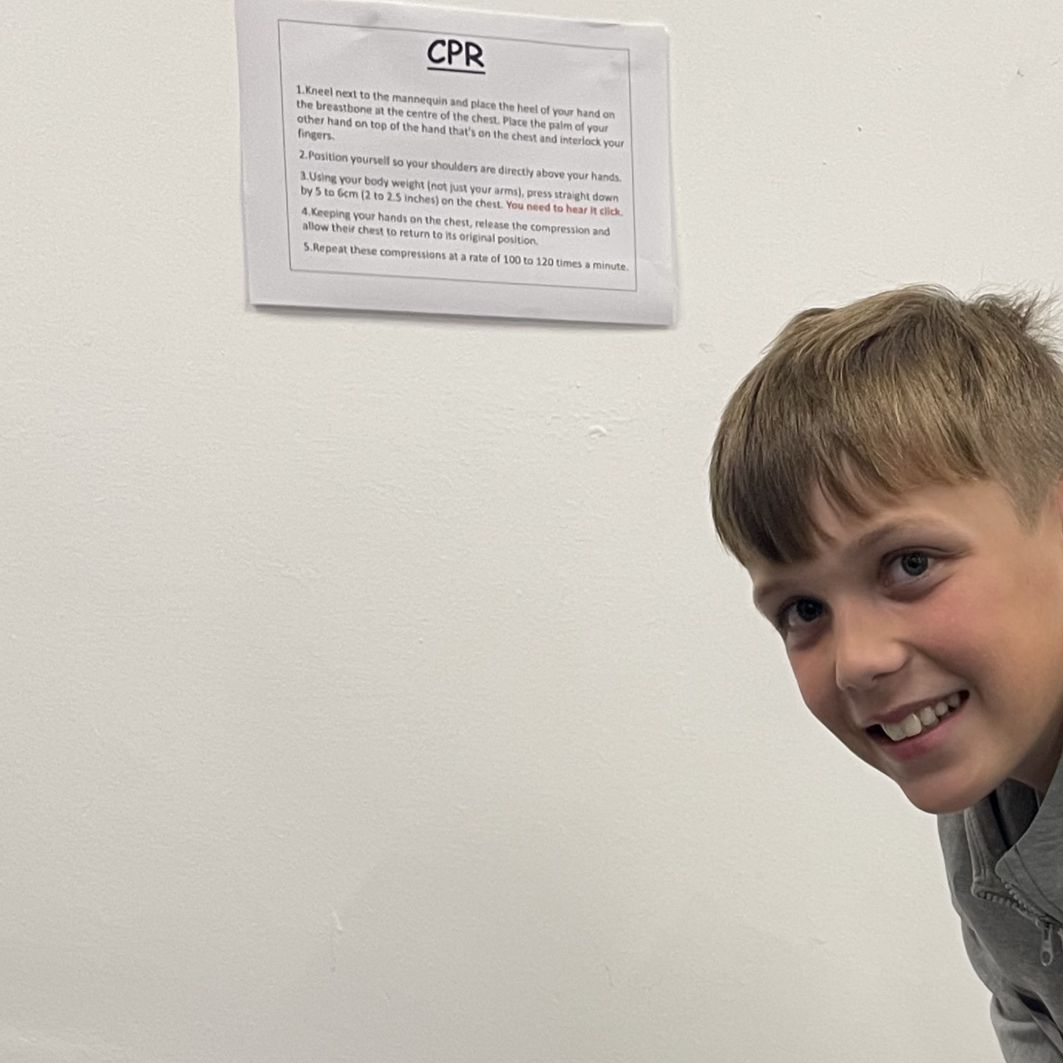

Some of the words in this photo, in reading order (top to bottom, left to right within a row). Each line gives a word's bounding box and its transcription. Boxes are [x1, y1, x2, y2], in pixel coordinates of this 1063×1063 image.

[426, 39, 485, 68] CPR
[296, 100, 314, 109] the
[315, 101, 373, 114] breastbone
[374, 107, 385, 115] at
[387, 107, 404, 116] the
[406, 111, 438, 119] centre
[439, 111, 451, 120] of
[452, 112, 469, 121] the
[471, 114, 500, 124] chest.
[502, 116, 528, 127] Place
[529, 119, 547, 128] the
[548, 121, 573, 130] palm
[574, 122, 585, 130] of
[335, 90, 358, 98] next
[359, 91, 371, 99] to
[372, 92, 390, 101] the
[391, 95, 448, 106] mannequin
[449, 99, 469, 107] and
[470, 100, 497, 109] place
[498, 102, 515, 111] the
[516, 104, 539, 113] heel
[540, 106, 551, 114] of
[576, 109, 601, 118] hand
[296, 115, 324, 125] other
[327, 117, 352, 127] hand
[370, 121, 387, 131] top
[390, 122, 400, 130] of
[402, 123, 419, 132] the
[421, 124, 446, 134] hand
[448, 127, 476, 136] that's
[493, 130, 509, 139] the
[511, 132, 537, 142] chest
[540, 135, 558, 143] and
[560, 136, 601, 146] interlock
[297, 128, 338, 140] fingers.
[350, 156, 391, 165] yourself
[405, 161, 429, 169] your
[430, 160, 479, 172] shoulders
[497, 166, 534, 178] directly
[535, 169, 566, 178] above
[566, 173, 589, 181] your
[590, 172, 623, 182] hands.
[300, 186, 313, 197] by
[315, 187, 322, 196] 5
[324, 188, 335, 196] to
[336, 188, 359, 198] 6cm
[361, 191, 371, 200] (2
[373, 192, 385, 200] to
[386, 192, 402, 202] 2.5
[404, 194, 440, 206] inches)
[456, 197, 473, 206] the
[474, 199, 504, 208] chest.
[505, 201, 525, 210] You
[565, 204, 588, 214] hear
[599, 207, 624, 216] click.
[339, 177, 362, 185] your
[364, 176, 389, 187] body
[391, 181, 425, 190] weight
[427, 181, 447, 191] (not
[449, 184, 468, 193] just
[494, 188, 525, 197] arms),
[526, 190, 553, 198] press
[554, 191, 590, 201] straight
[592, 193, 619, 201] down
[301, 222, 330, 231] allow
[331, 223, 356, 233] their
[357, 226, 385, 235] chest
[385, 228, 398, 236] to
[399, 229, 431, 238] return
[432, 231, 444, 239] to
[444, 232, 458, 240] its
[458, 234, 496, 243] original
[497, 236, 539, 245] position.
[352, 213, 376, 221] your
[377, 212, 408, 223] hands
[424, 216, 442, 225] the
[443, 217, 473, 228] chest,
[474, 220, 510, 229] release
[511, 222, 528, 231] the
[530, 224, 591, 234] compression
[592, 228, 611, 236] and
[350, 244, 378, 256] these
[379, 247, 446, 261] compressions
[449, 252, 458, 262] at
[460, 254, 467, 262] a
[469, 254, 489, 264] rate
[490, 253, 501, 264] of
[503, 254, 522, 265] 100
[523, 256, 534, 266] to
[536, 257, 554, 267] 120
[556, 258, 583, 269] times
[585, 261, 591, 269] a
[593, 261, 630, 272] minute.
